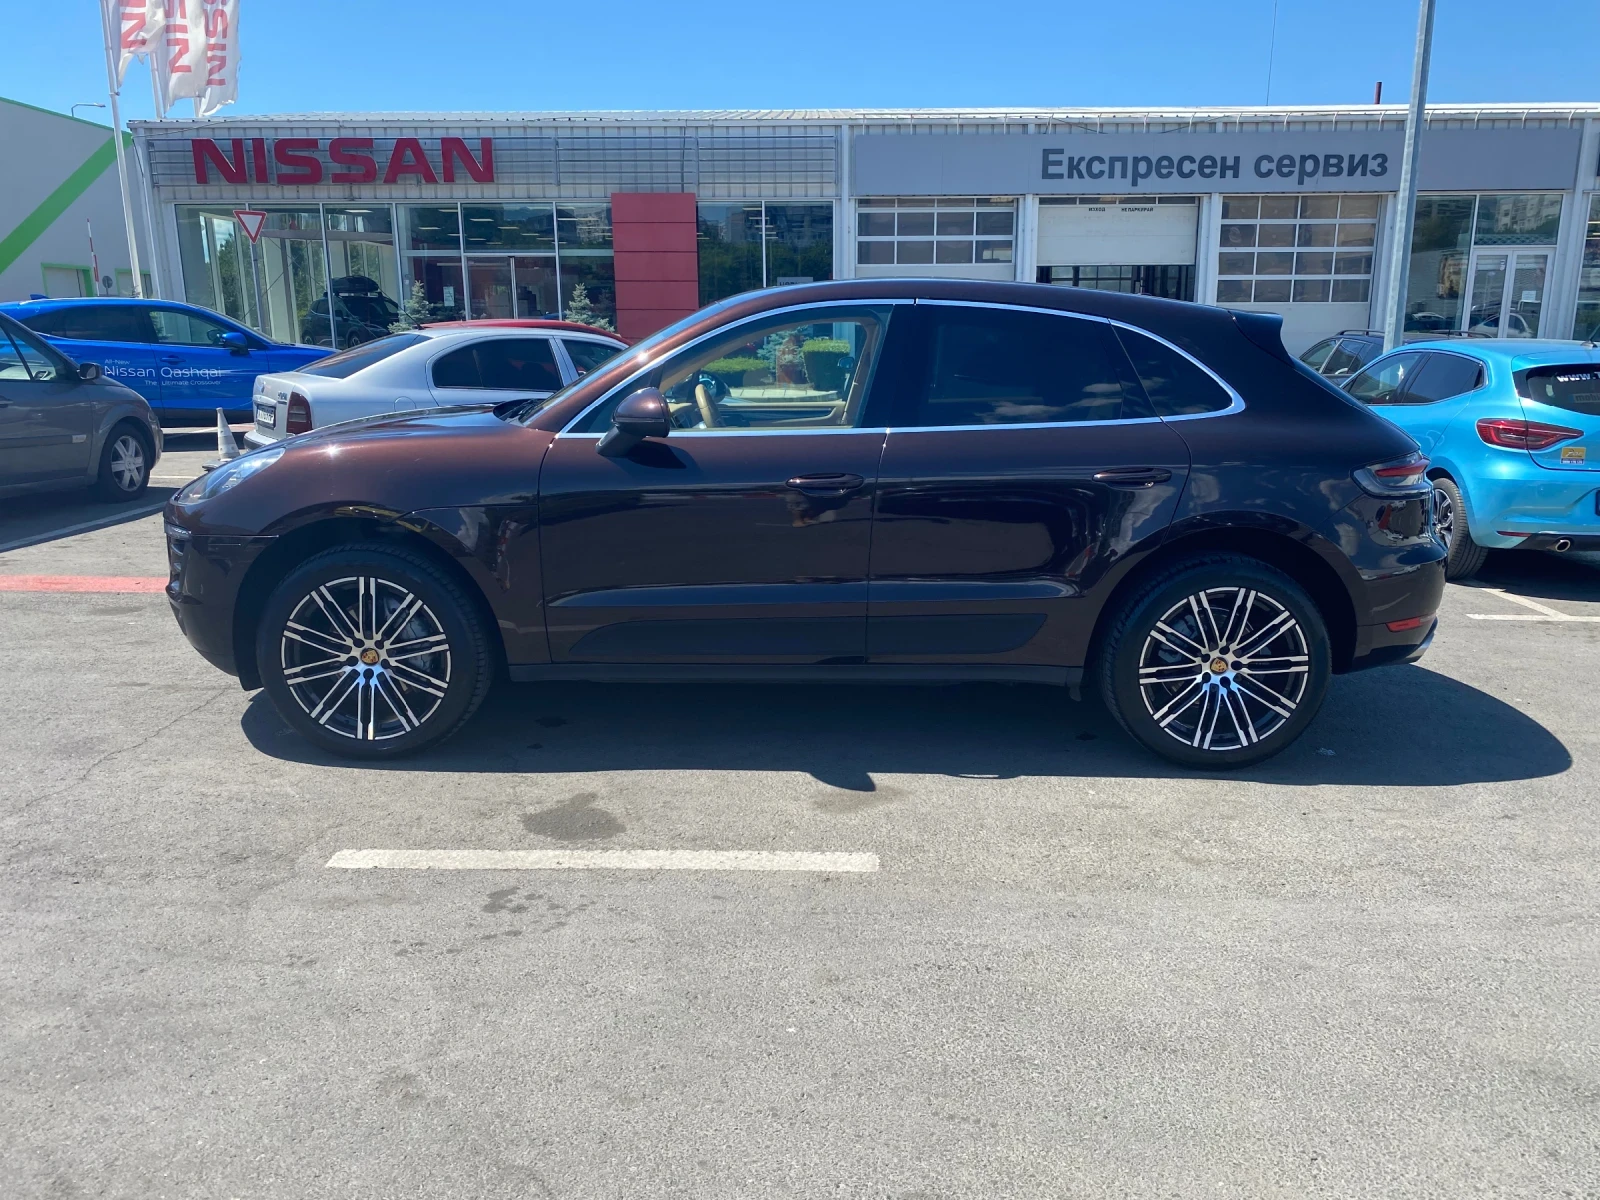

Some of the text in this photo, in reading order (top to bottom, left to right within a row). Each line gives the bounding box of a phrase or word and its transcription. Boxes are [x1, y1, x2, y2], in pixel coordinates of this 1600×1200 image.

[191, 137, 495, 185] NISSAN
[1041, 148, 1389, 187] Експресен сервиз
[104, 365, 222, 379] Nissan Qashqai
